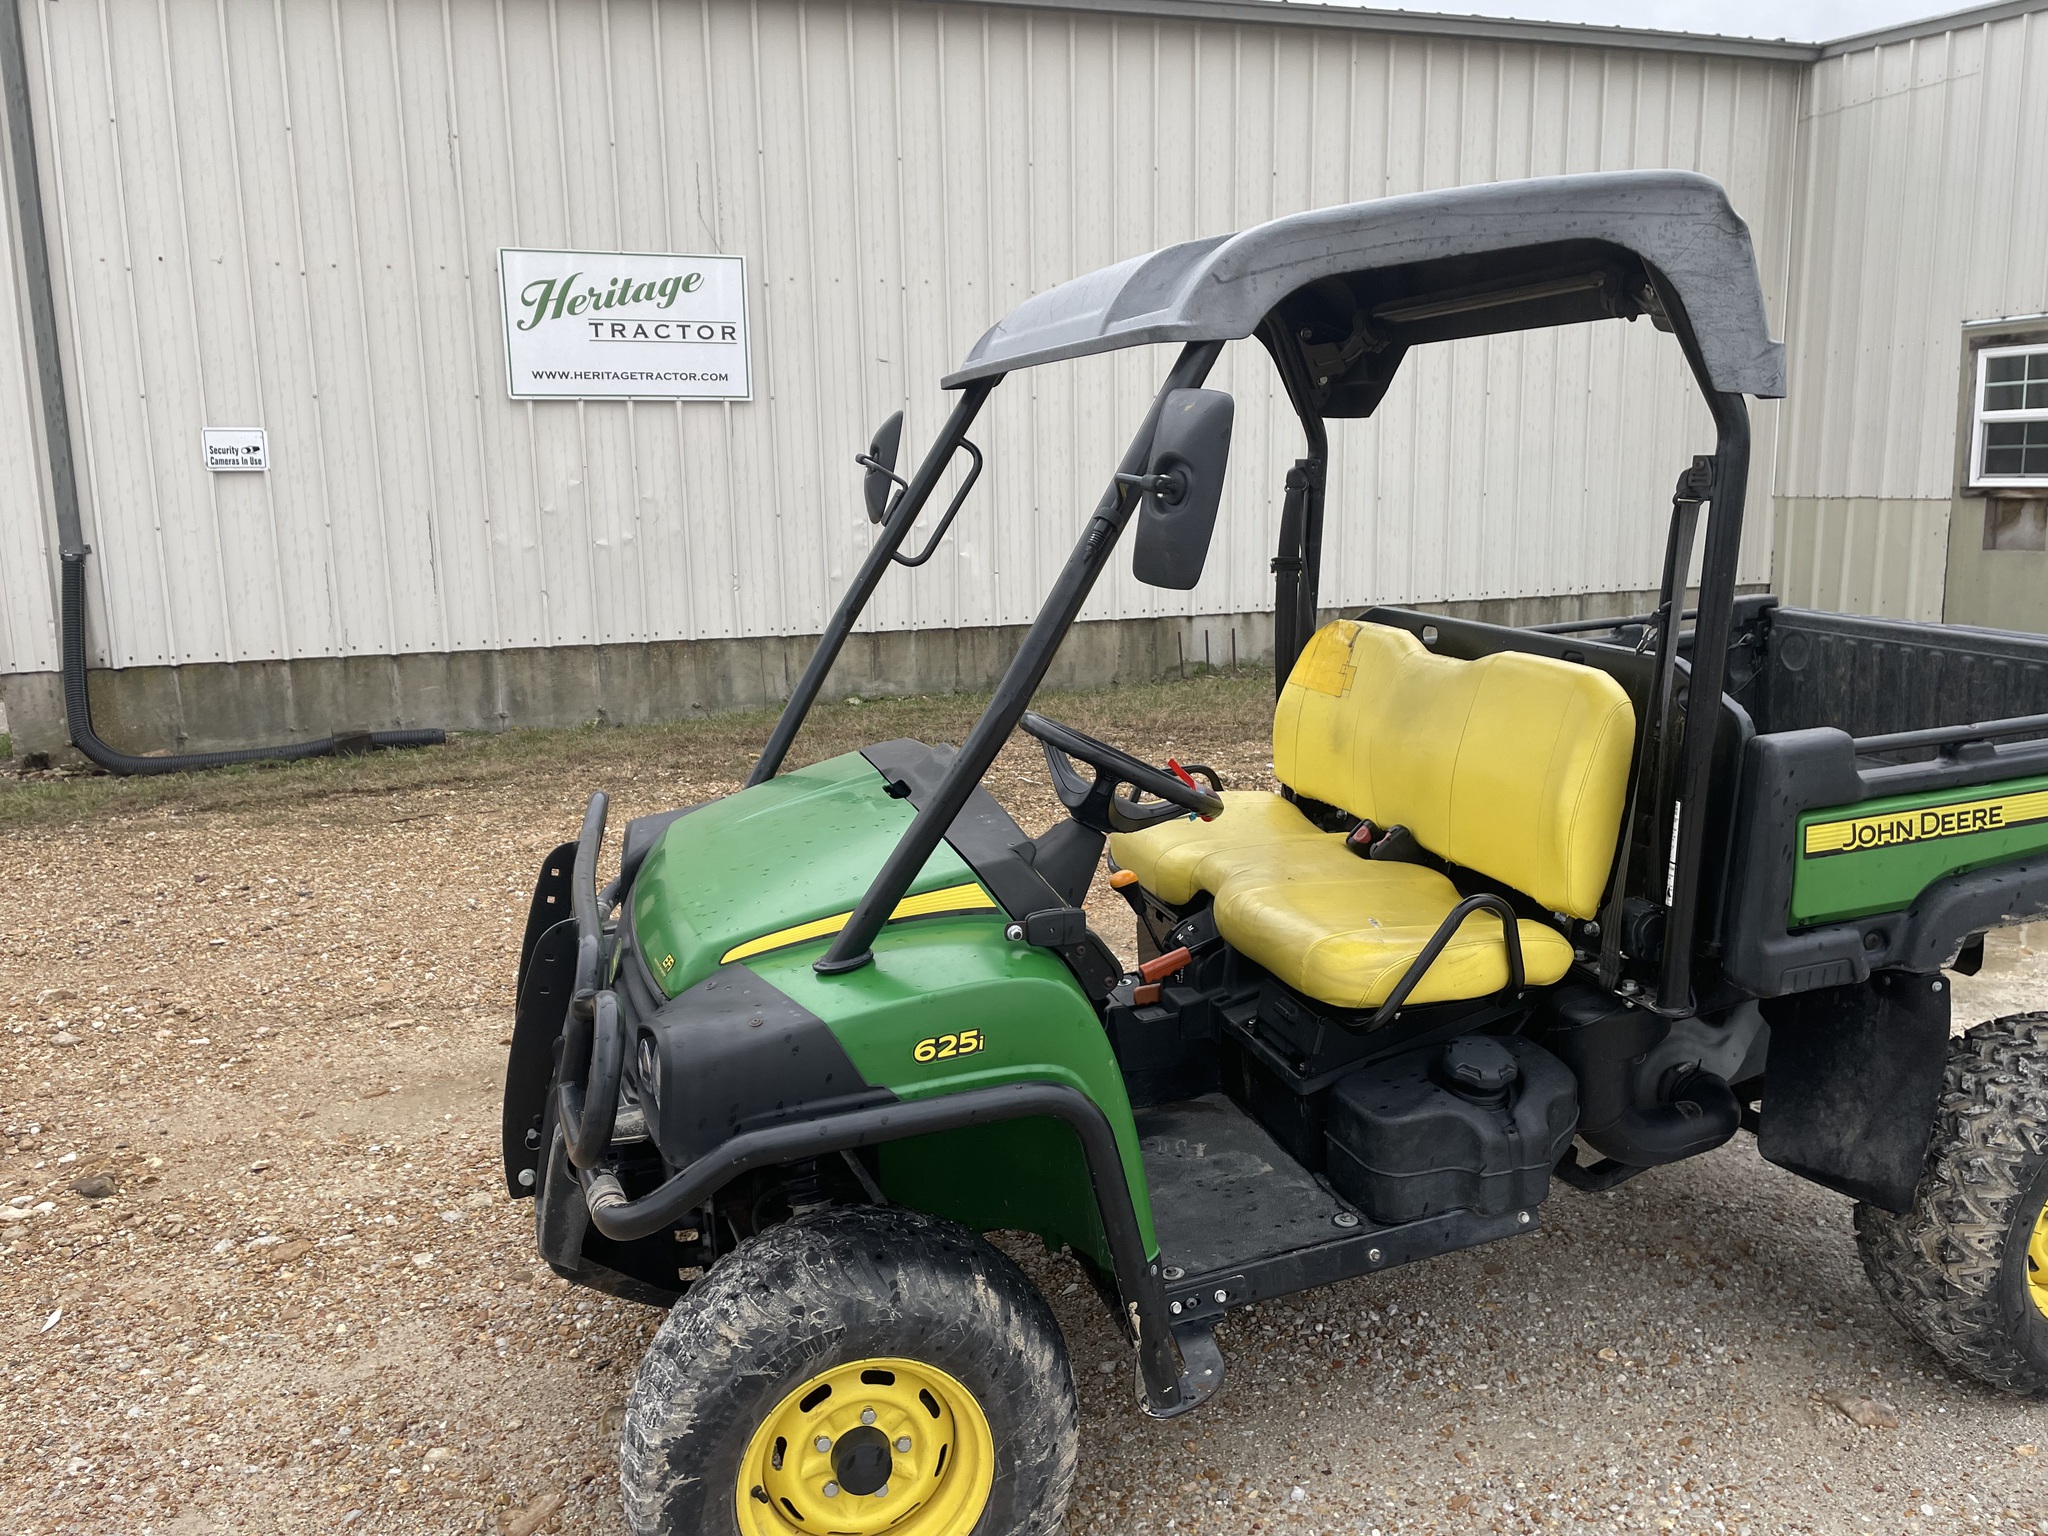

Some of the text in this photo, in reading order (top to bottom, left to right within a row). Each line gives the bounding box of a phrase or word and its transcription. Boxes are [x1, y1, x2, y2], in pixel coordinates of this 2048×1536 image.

[516, 271, 705, 331] Heritage
[588, 322, 737, 341] TRACTOR
[531, 370, 729, 382] WWW.HERITAGETRACTOR.COM
[209, 445, 239, 456] Security
[210, 456, 262, 465] Cameras In Use
[1842, 805, 2004, 849] JOHN DEERE
[913, 1028, 985, 1063] 625i
